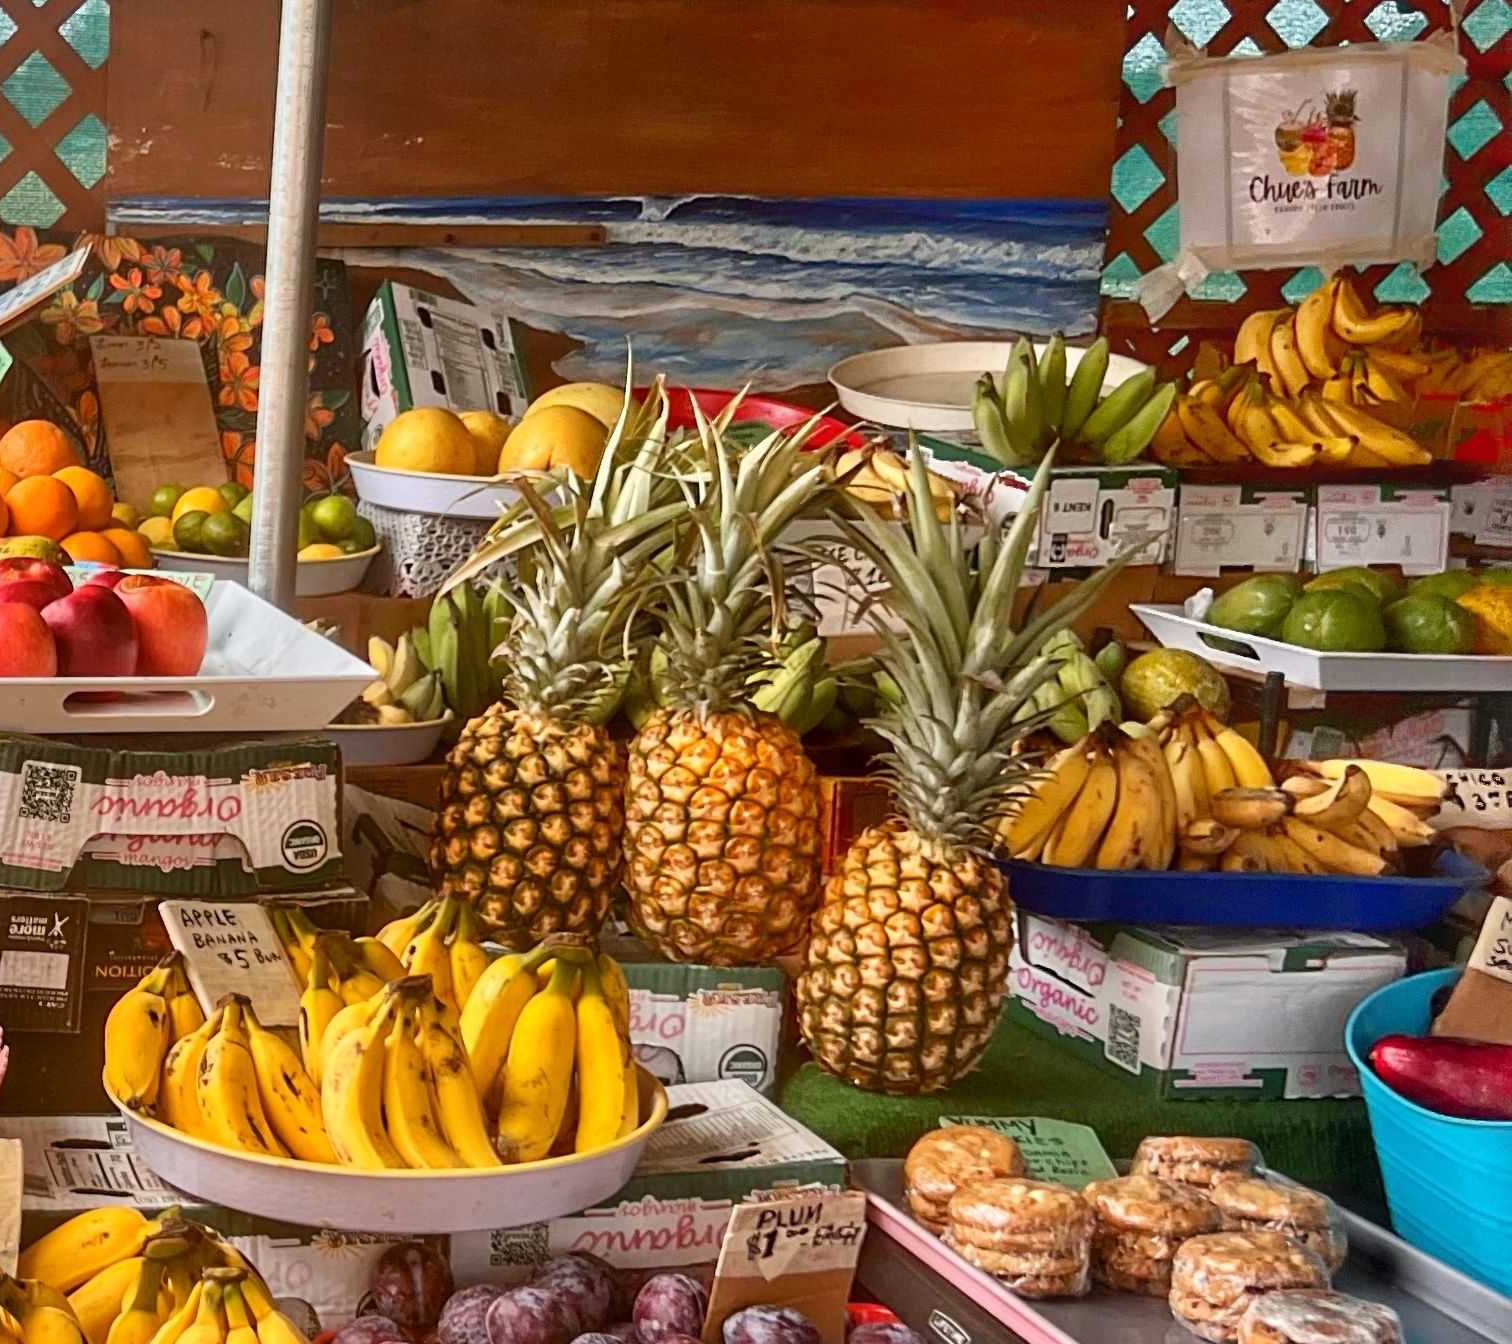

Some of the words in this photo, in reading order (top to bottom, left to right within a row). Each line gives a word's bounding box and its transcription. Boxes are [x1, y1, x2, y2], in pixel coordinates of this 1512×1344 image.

[1249, 174, 1318, 204] Chue's
[1327, 173, 1384, 200] Farm
[90, 787, 242, 823] Organic
[8, 924, 47, 937] more
[180, 907, 238, 928] APPLE
[192, 930, 259, 949] BANANA
[1015, 966, 1101, 1026] Organic
[756, 1202, 823, 1230] PLUM
